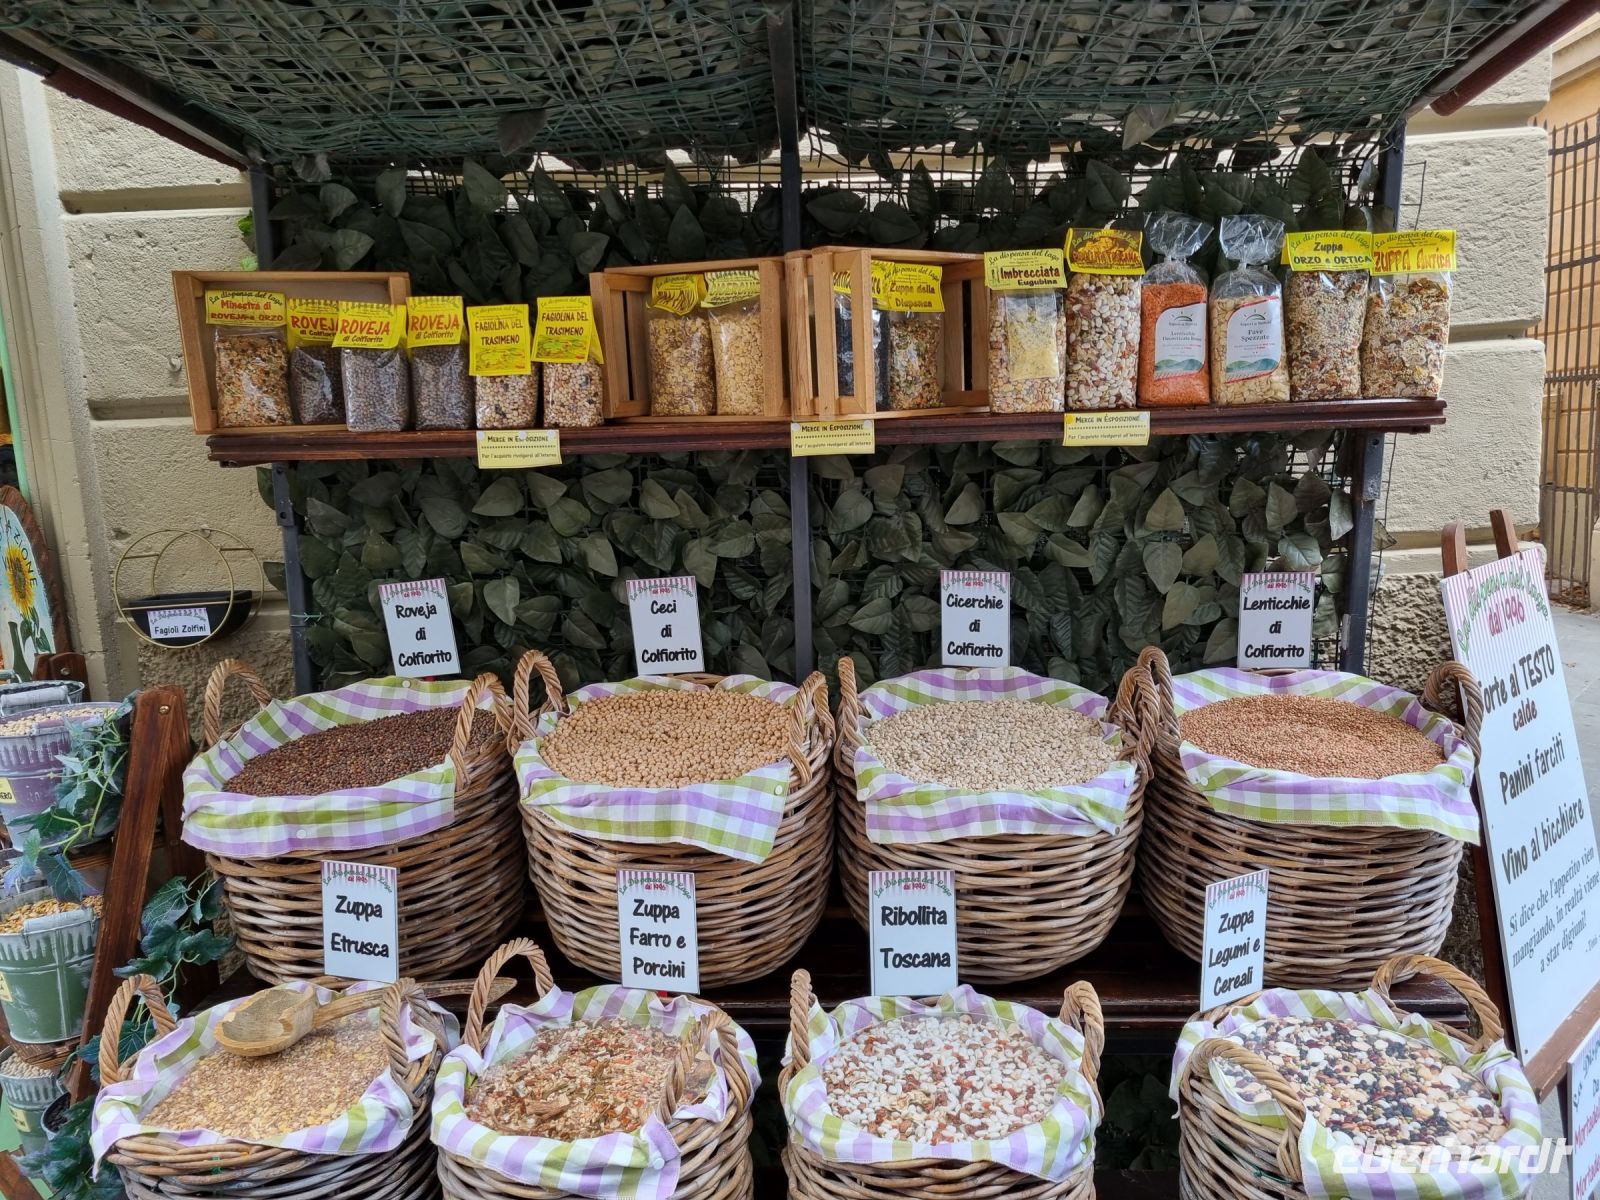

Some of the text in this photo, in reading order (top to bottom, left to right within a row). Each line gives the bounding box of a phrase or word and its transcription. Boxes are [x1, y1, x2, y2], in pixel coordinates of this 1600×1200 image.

[1303, 231, 1338, 242] dispensa
[1387, 231, 1419, 242] dispensa
[1000, 250, 1030, 259] dispensa
[1313, 242, 1343, 254] Zuppa
[1293, 256, 1321, 264] ORZO
[1334, 255, 1372, 264] ORTICA
[1000, 265, 1060, 279] Imbrecciata
[890, 281, 914, 295] Zuppa
[917, 282, 936, 294] della
[220, 300, 272, 310] Minestra di
[410, 314, 460, 331] ROVEJA
[475, 318, 524, 331] FAGIOLINA DEL
[541, 312, 588, 321] FAGIOLINA DEL
[340, 319, 391, 335] ROVEJA
[423, 330, 454, 339] Colfiorito
[545, 326, 584, 336] TRASIMENO
[351, 335, 383, 343] Colfiorito
[480, 334, 520, 346] TRASIMENO
[650, 600, 677, 615] Ceci
[946, 593, 1004, 609] Cicerchie
[1243, 596, 1310, 610] Lenticchie
[395, 602, 437, 619] Roveja
[1488, 594, 1525, 637] dal 1996
[154, 624, 206, 636] Fagioli Zolfini
[660, 624, 672, 638] di
[969, 619, 981, 632] di
[1269, 621, 1282, 634] di
[415, 627, 427, 641] di
[641, 648, 697, 663] Colfiorito
[947, 641, 1003, 657] Colfiorito
[1244, 644, 1305, 658] Colfiorito
[398, 650, 452, 667] Colfiorito
[1478, 643, 1555, 714] orte al TESTO
[1512, 698, 1538, 731] calde
[1499, 732, 1565, 805] Panini farciti
[1501, 798, 1584, 885] Vino al bicchiere
[1510, 847, 1594, 937] Si dice che l'appetito vien
[335, 894, 383, 922] Zuppa
[633, 898, 680, 923] Zuppa
[881, 905, 948, 927] Ribollita
[1218, 909, 1255, 934] Zuppa
[630, 927, 686, 949] Farro e
[1512, 915, 1555, 968] mangiando,
[1556, 905, 1563, 924] in
[1540, 910, 1587, 973] a star digiuni!
[331, 932, 389, 958] Etrusca
[1208, 936, 1261, 968] Legumi e
[880, 947, 951, 969] Toscana
[633, 956, 686, 978] Porcini
[1213, 965, 1254, 997] Cereali
